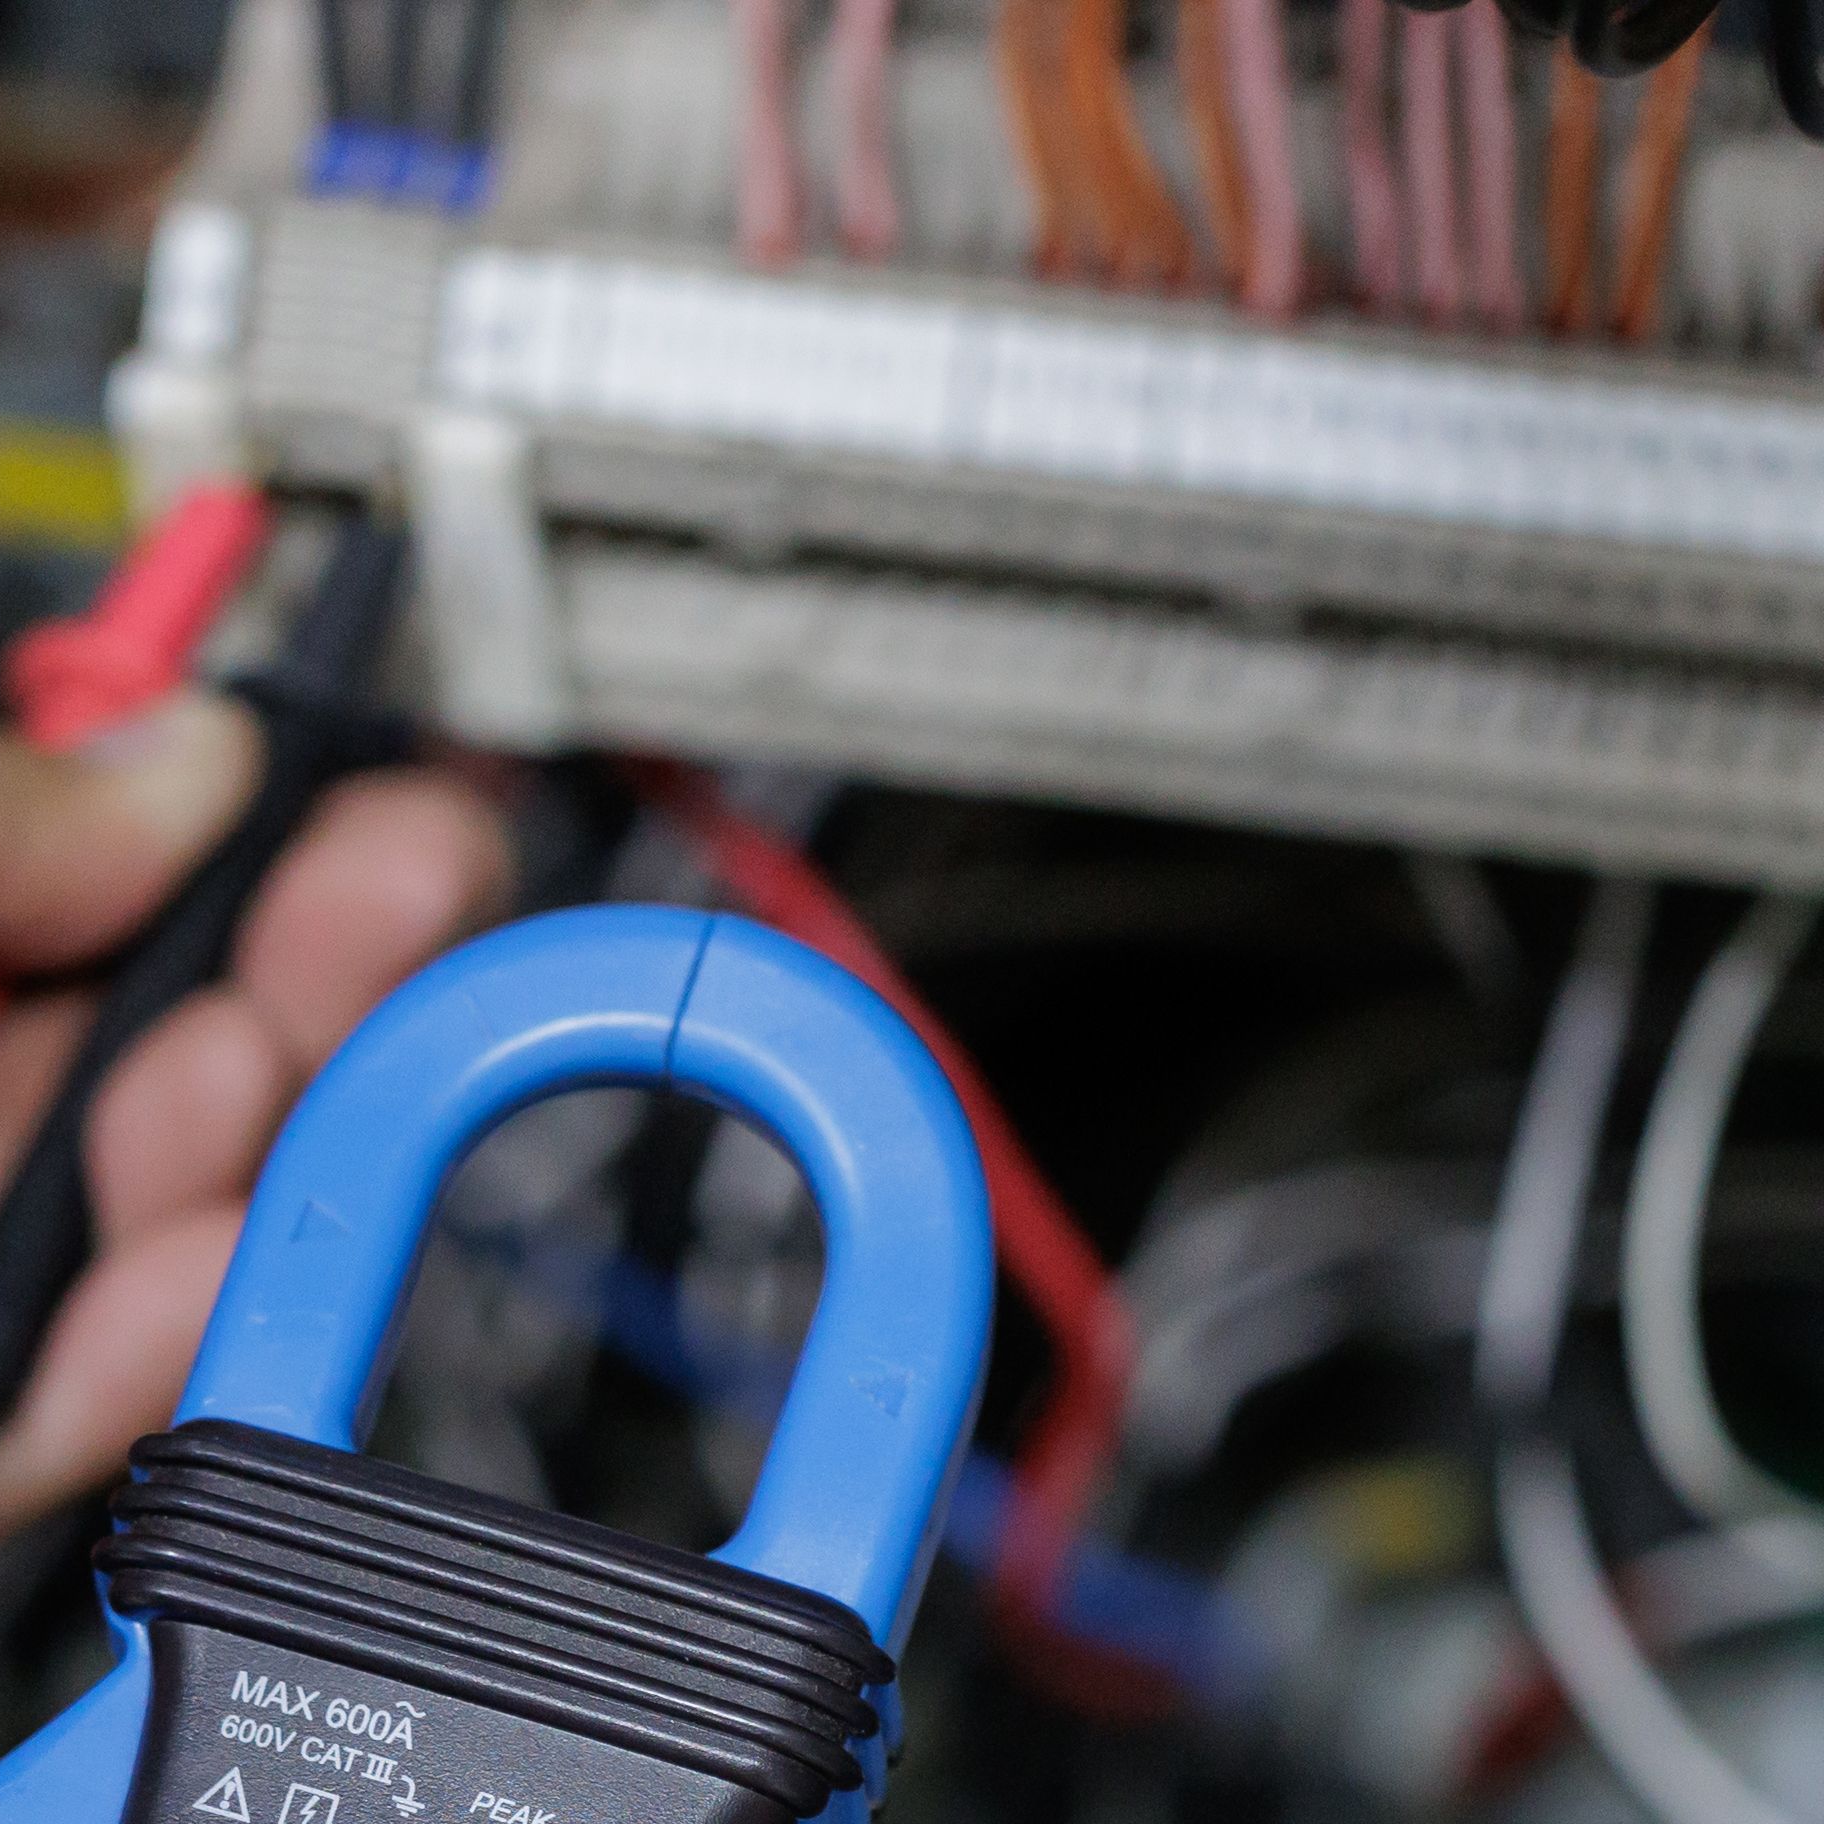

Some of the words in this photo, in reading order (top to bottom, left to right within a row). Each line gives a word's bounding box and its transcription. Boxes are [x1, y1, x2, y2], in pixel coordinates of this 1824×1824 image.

[231, 1670, 320, 1721] MAX
[221, 1714, 297, 1752] 600V
[301, 1737, 363, 1772] CAT
